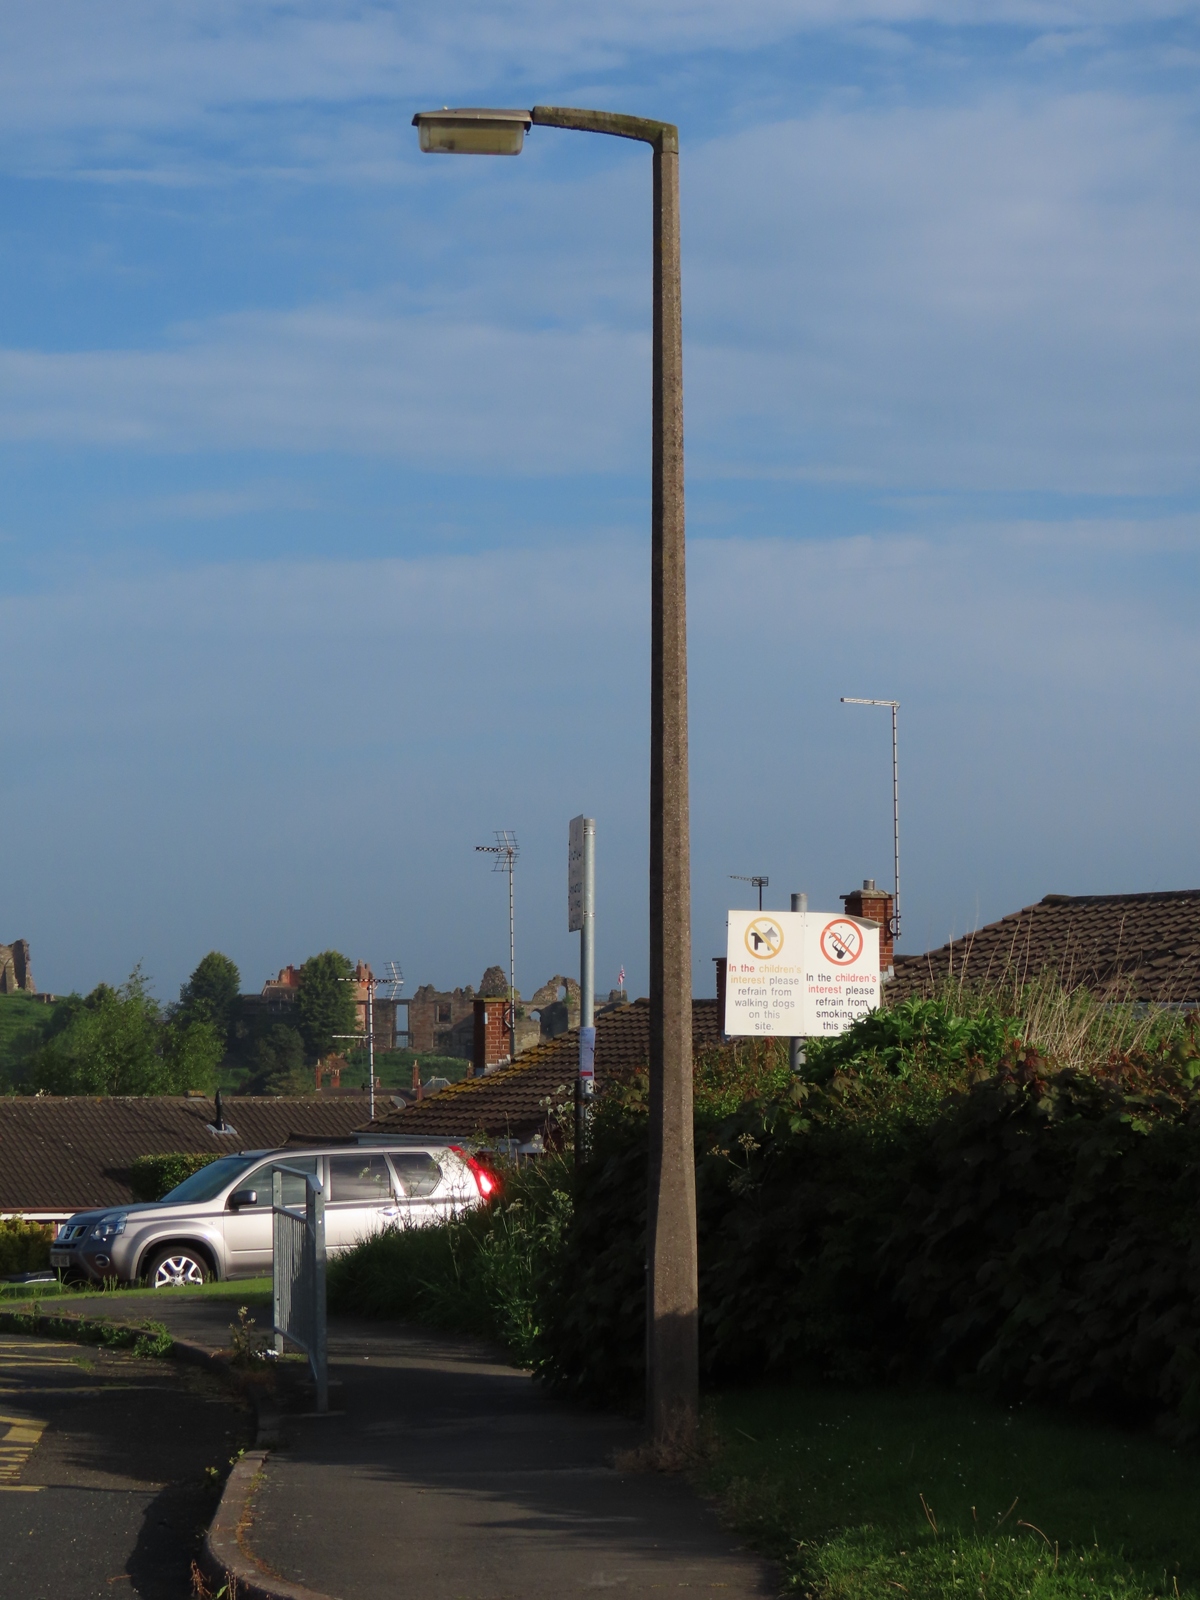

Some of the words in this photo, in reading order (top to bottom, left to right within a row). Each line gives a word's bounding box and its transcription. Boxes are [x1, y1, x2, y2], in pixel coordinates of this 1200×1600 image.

[728, 963, 737, 972] In
[740, 963, 755, 973] the
[758, 964, 802, 974] children's
[730, 975, 765, 985] interest
[769, 976, 799, 986] please
[806, 972, 814, 982] In
[817, 973, 832, 982] the
[835, 973, 877, 983] children's
[738, 987, 767, 996] refrain
[771, 987, 792, 997] from
[808, 984, 842, 994] interest
[845, 985, 875, 996] please
[734, 998, 769, 1010] walking
[772, 999, 795, 1010] dogs
[815, 997, 844, 1006] refrain
[847, 997, 868, 1007] from
[748, 1011, 760, 1019] on
[764, 1010, 781, 1019] this
[816, 1009, 853, 1021] smoking
[754, 1021, 774, 1031] site.
[823, 1021, 839, 1030] this
